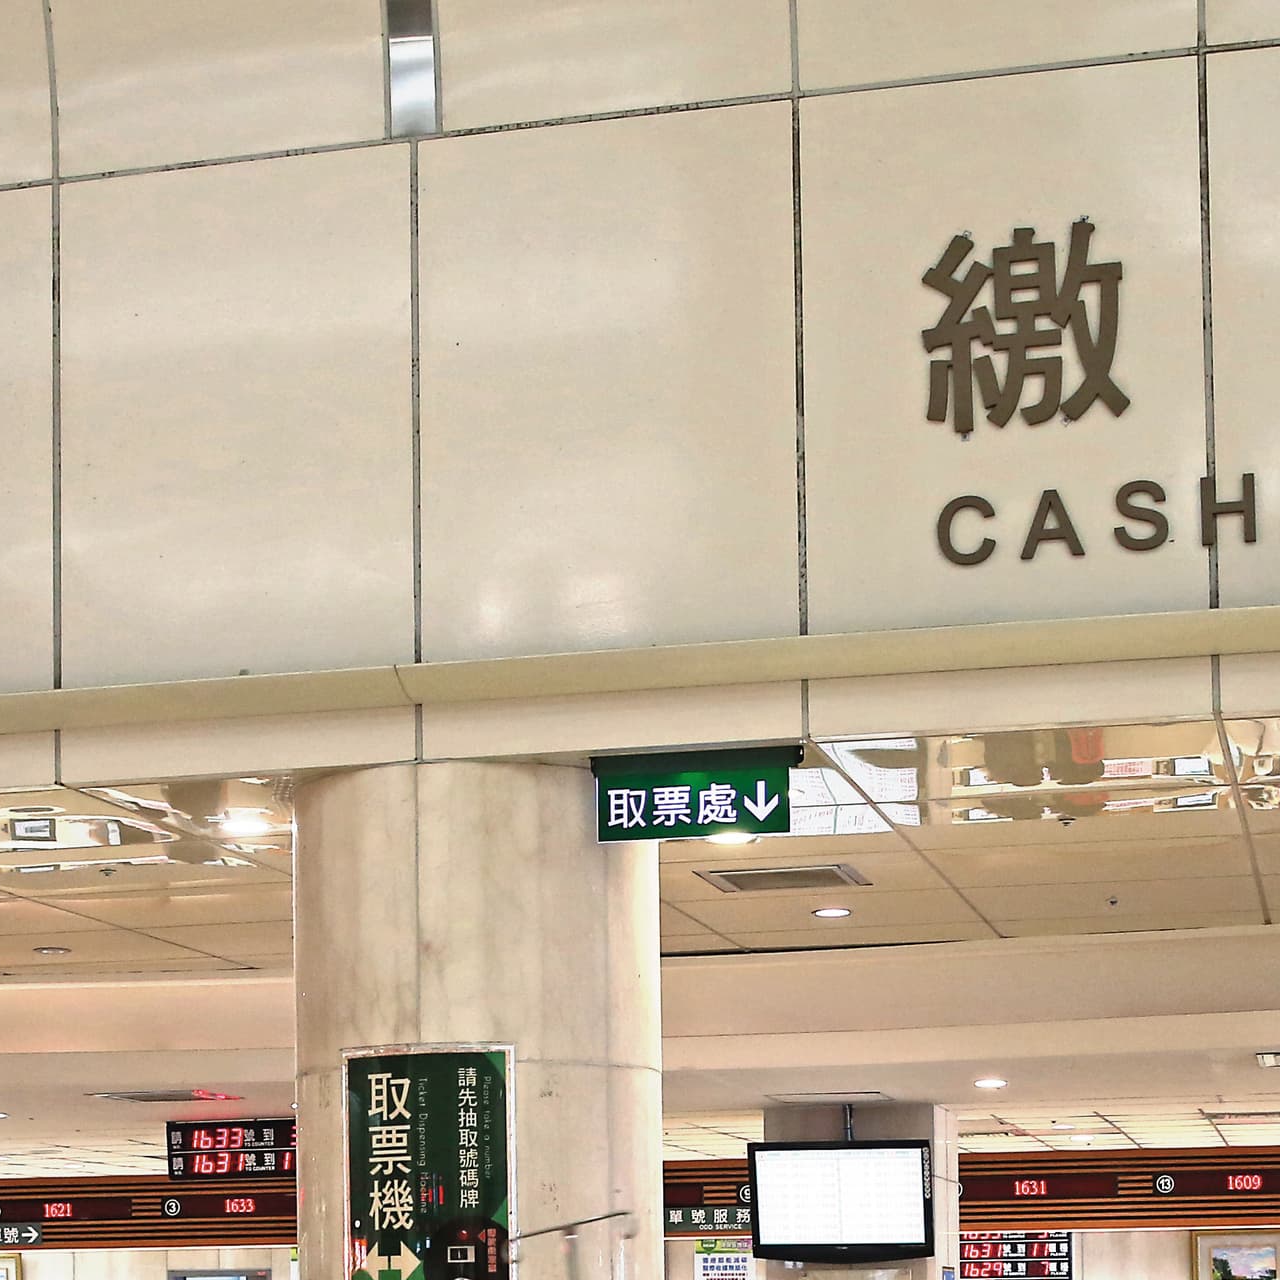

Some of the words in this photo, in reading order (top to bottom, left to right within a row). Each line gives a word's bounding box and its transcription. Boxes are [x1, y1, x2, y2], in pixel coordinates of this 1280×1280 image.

[607, 782, 738, 829] 取票處
[192, 1127, 244, 1149] 1633
[417, 1113, 429, 1167] Dispensing
[457, 1066, 480, 1208] 請先抽取號碼牌
[367, 1072, 414, 1231] 取票機
[193, 1152, 245, 1173] 1631
[1014, 1181, 1047, 1195] 1631
[1227, 1175, 1262, 1190] 1609
[43, 1203, 72, 1217] 1621
[224, 1198, 255, 1213] 1633
[669, 1208, 751, 1224] 單號服務
[964, 1243, 1002, 1258] 1631
[1032, 1243, 1049, 1257] 11
[964, 1262, 1003, 1277] 1629
[1040, 1261, 1049, 1276] 7
